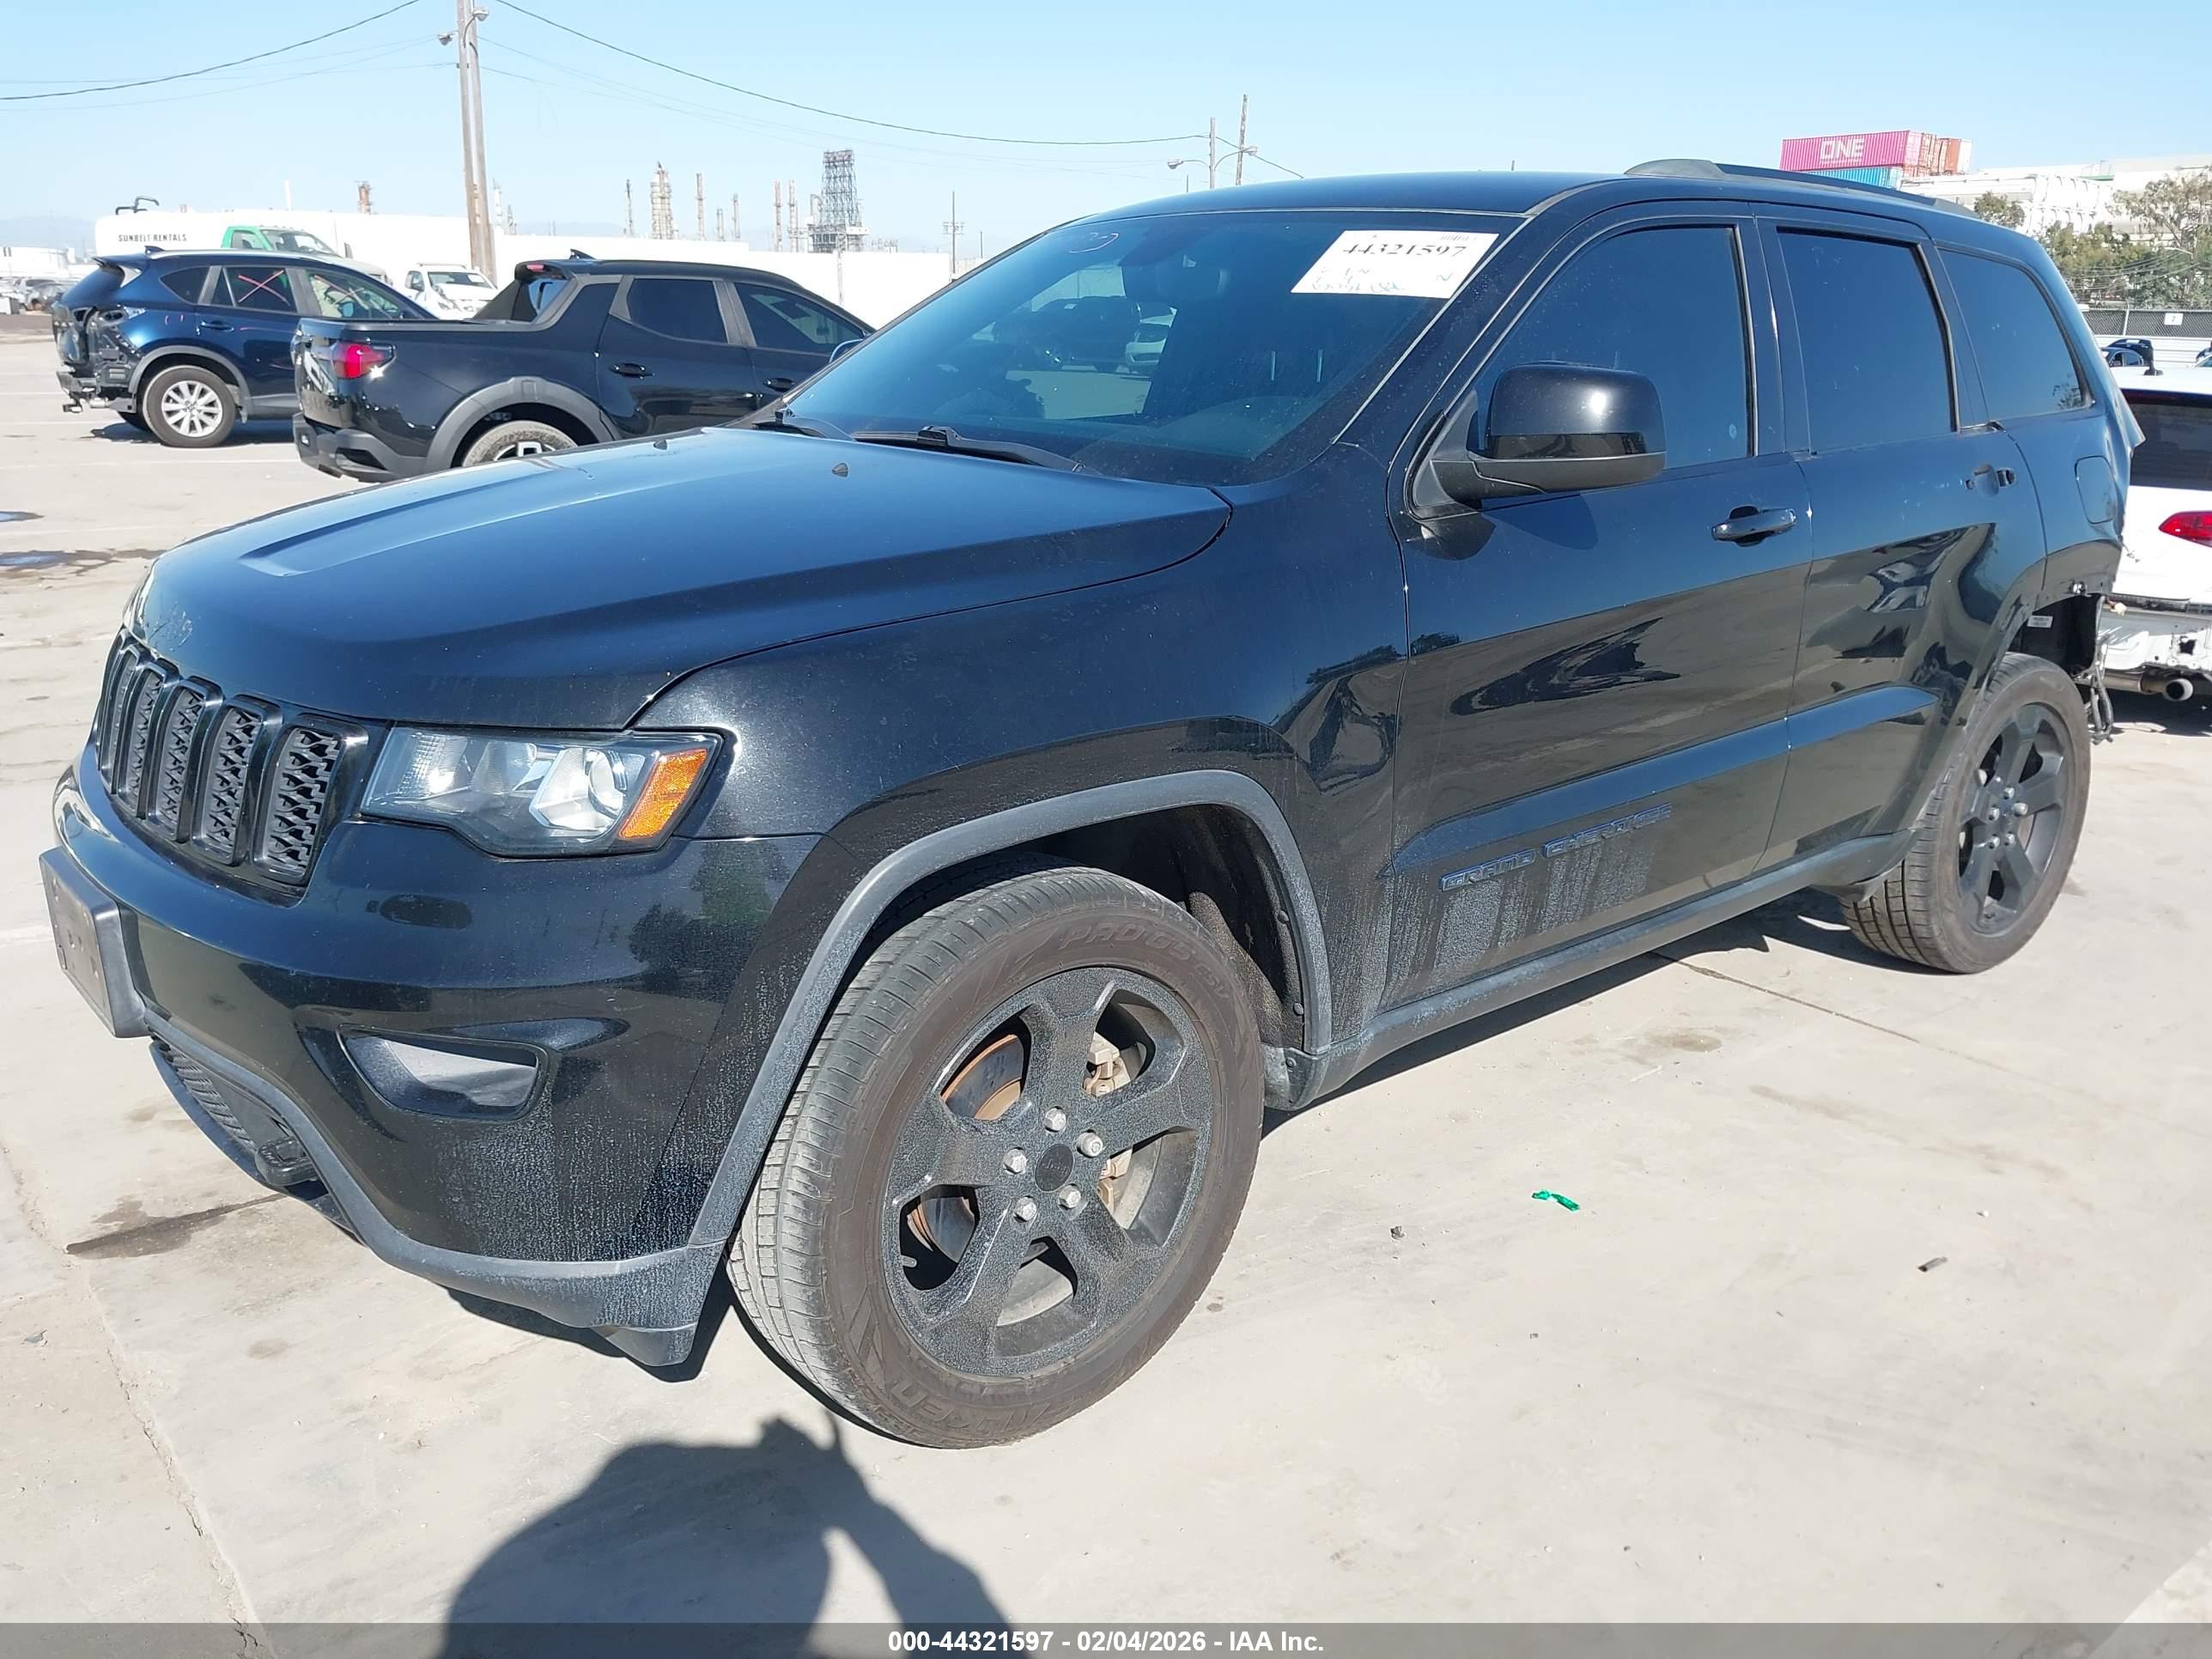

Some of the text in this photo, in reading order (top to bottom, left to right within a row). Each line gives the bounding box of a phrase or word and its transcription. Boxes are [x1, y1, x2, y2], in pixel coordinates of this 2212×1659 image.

[1820, 138, 1864, 160] ONE
[118, 234, 187, 242] SUNBELT RENTALS
[1342, 243, 1470, 257] 44321597
[1439, 802, 1673, 892] GRAND CHEROKEE
[1042, 1158, 1071, 1177] Jeep
